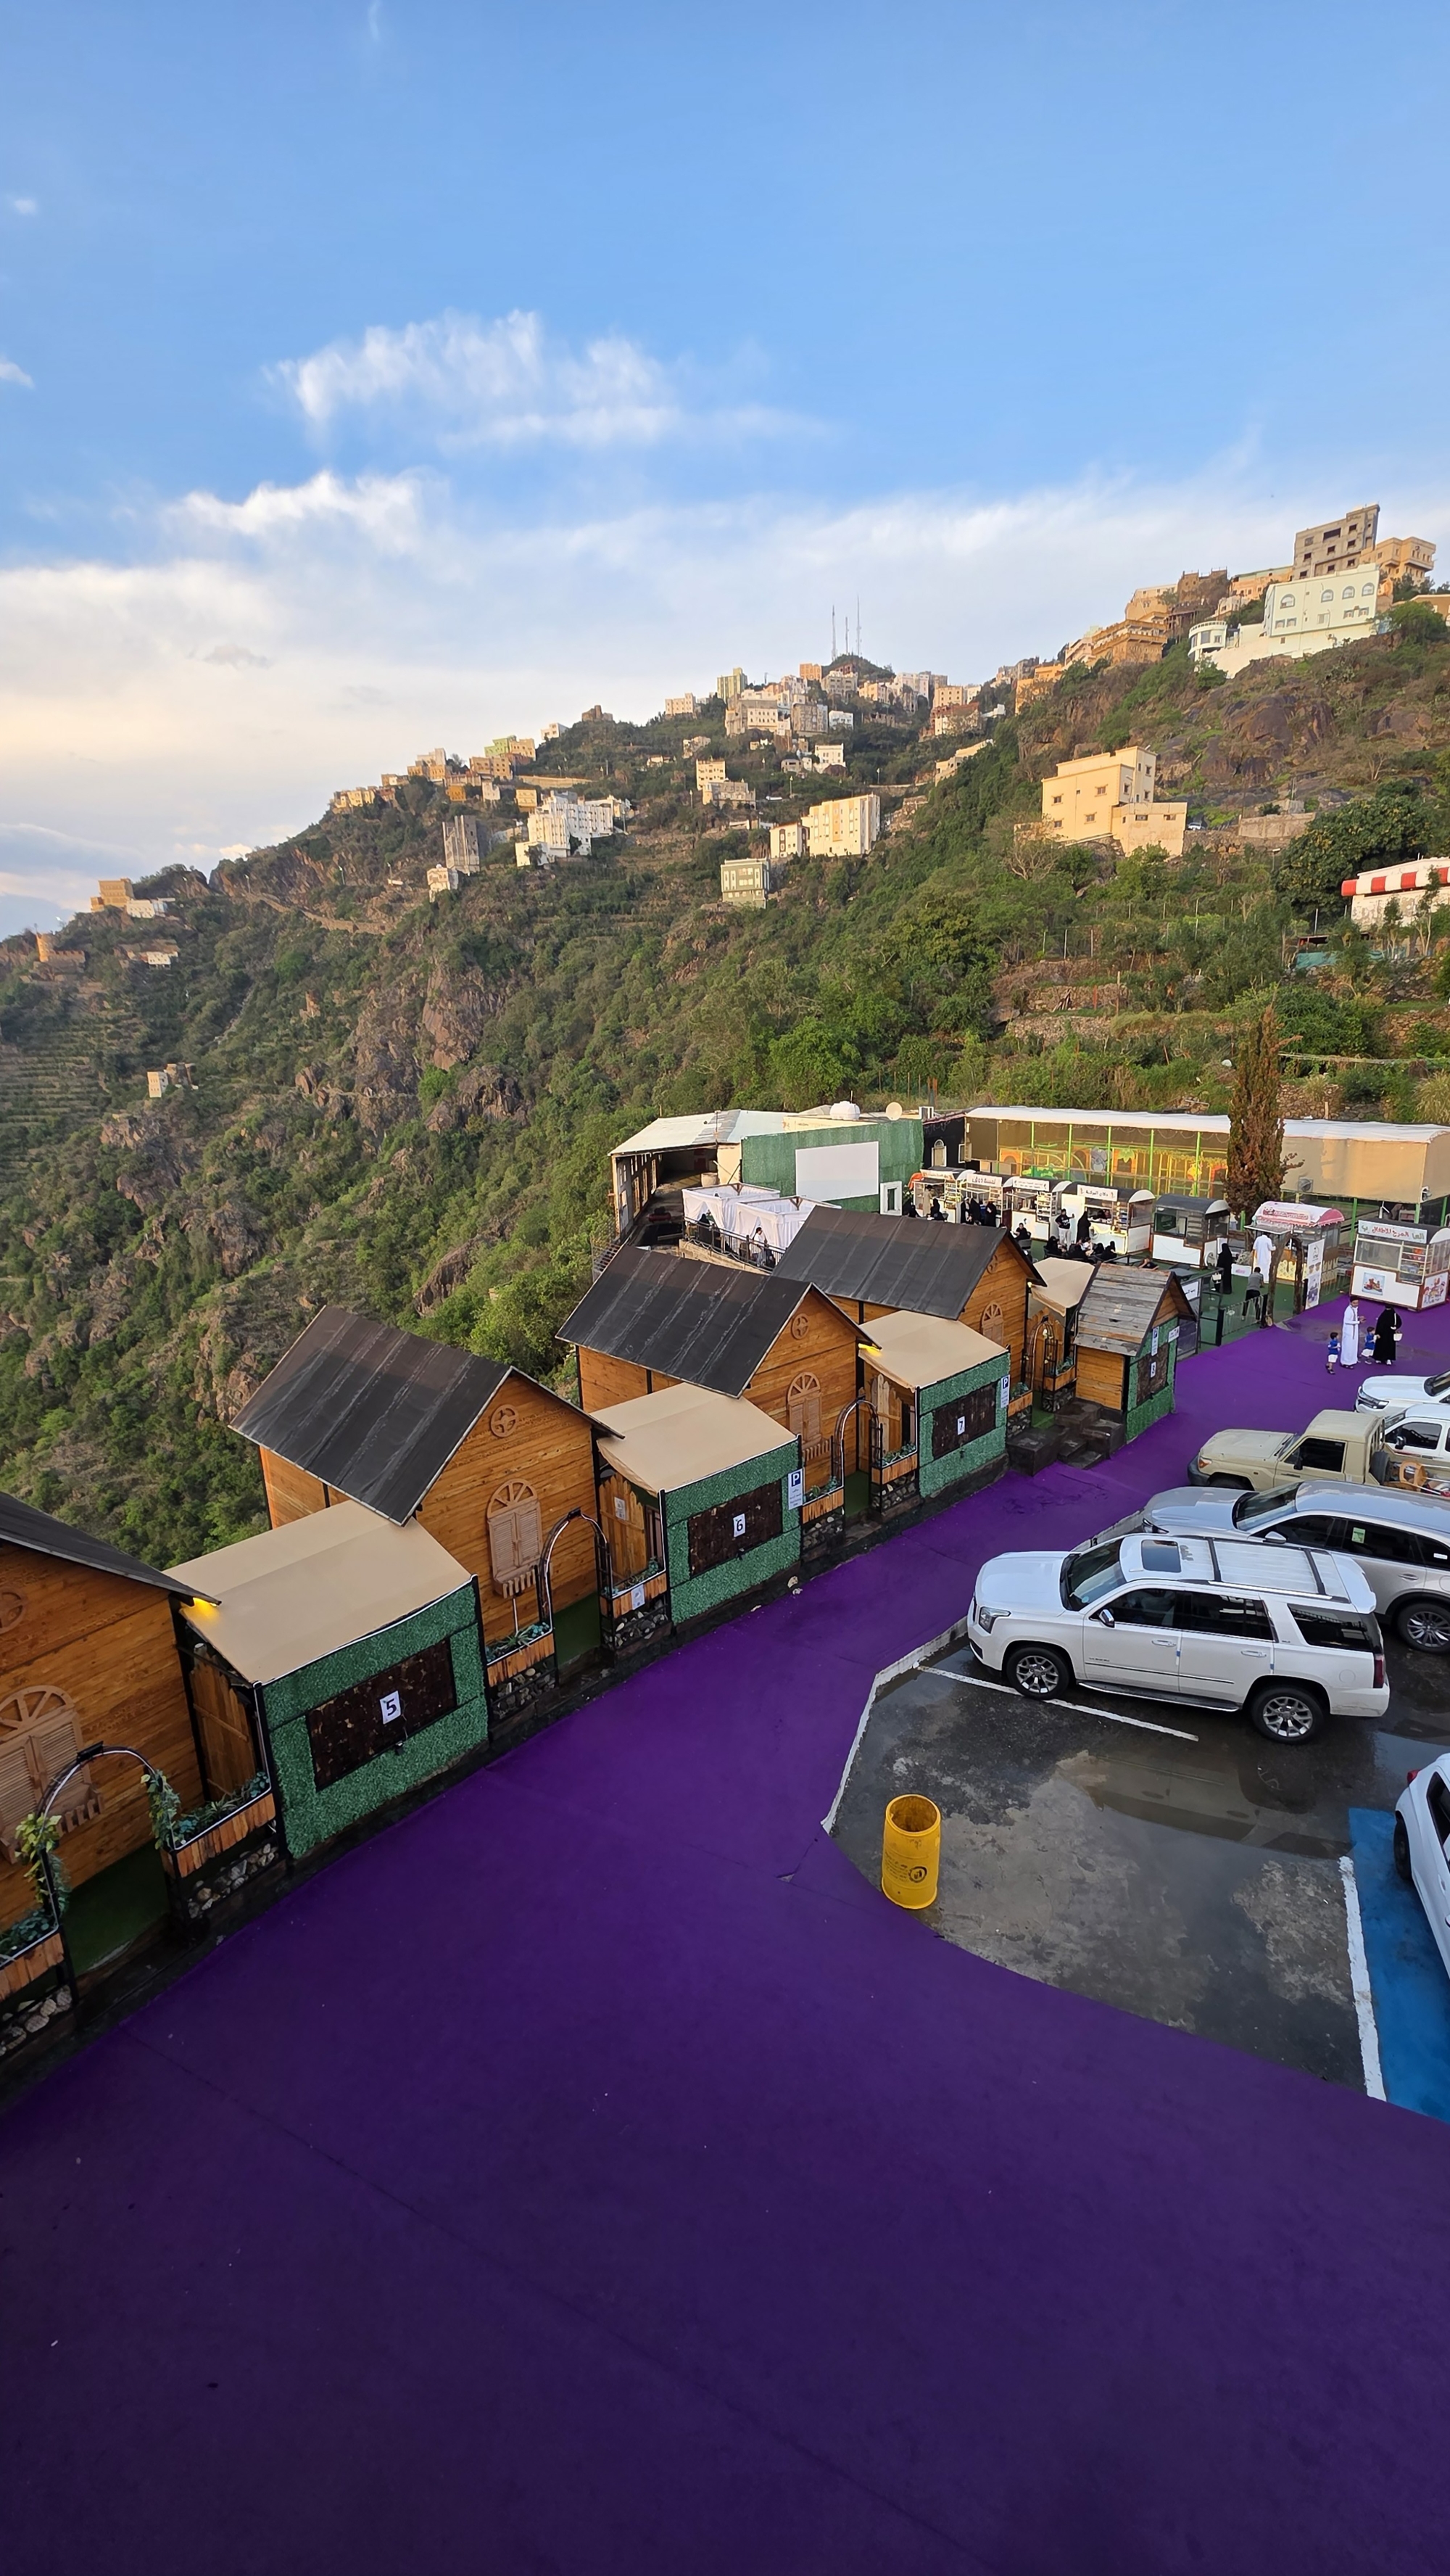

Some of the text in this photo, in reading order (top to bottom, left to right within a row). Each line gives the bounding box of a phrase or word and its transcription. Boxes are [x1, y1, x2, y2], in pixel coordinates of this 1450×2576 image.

[1003, 1378, 1008, 1388] P
[959, 1420, 964, 1431] 7
[792, 1473, 800, 1486] P
[737, 1519, 743, 1532] 6
[386, 1698, 397, 1717] 5
